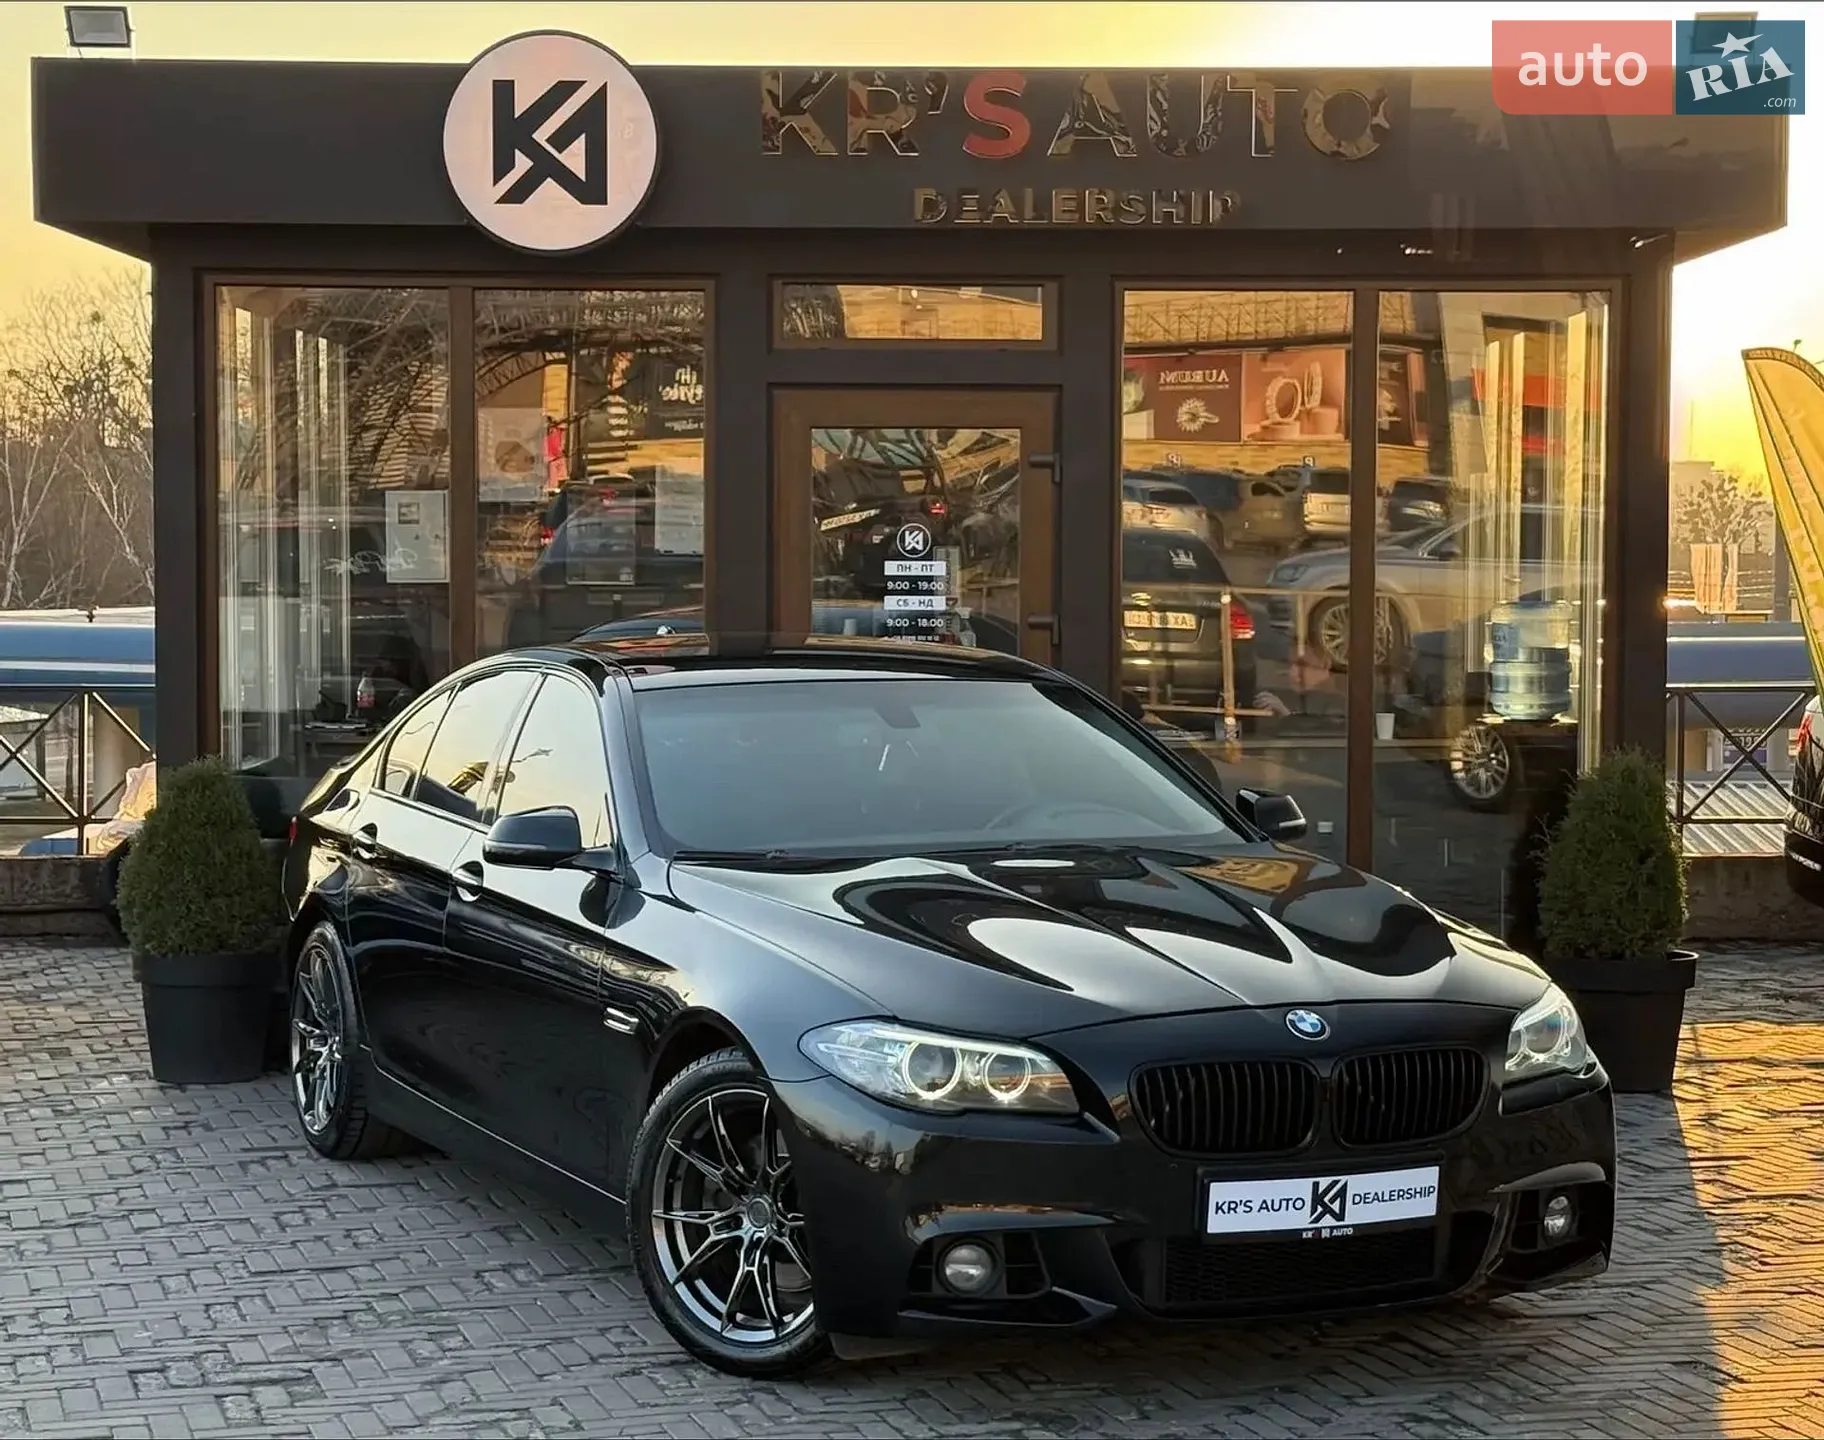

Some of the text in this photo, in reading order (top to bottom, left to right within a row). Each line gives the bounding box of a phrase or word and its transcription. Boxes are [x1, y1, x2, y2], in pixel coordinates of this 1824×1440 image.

[913, 188, 1240, 224] DEALERSHIP
[896, 565, 912, 573] ПН
[921, 563, 933, 573] ПТ
[918, 581, 944, 591] 19:00
[919, 599, 934, 608] НД
[1215, 1200, 1253, 1215] KR'S
[1257, 1197, 1306, 1212] AUTO
[1351, 1185, 1436, 1206] DEALERSHIP
[1332, 1227, 1353, 1237] AUTO
